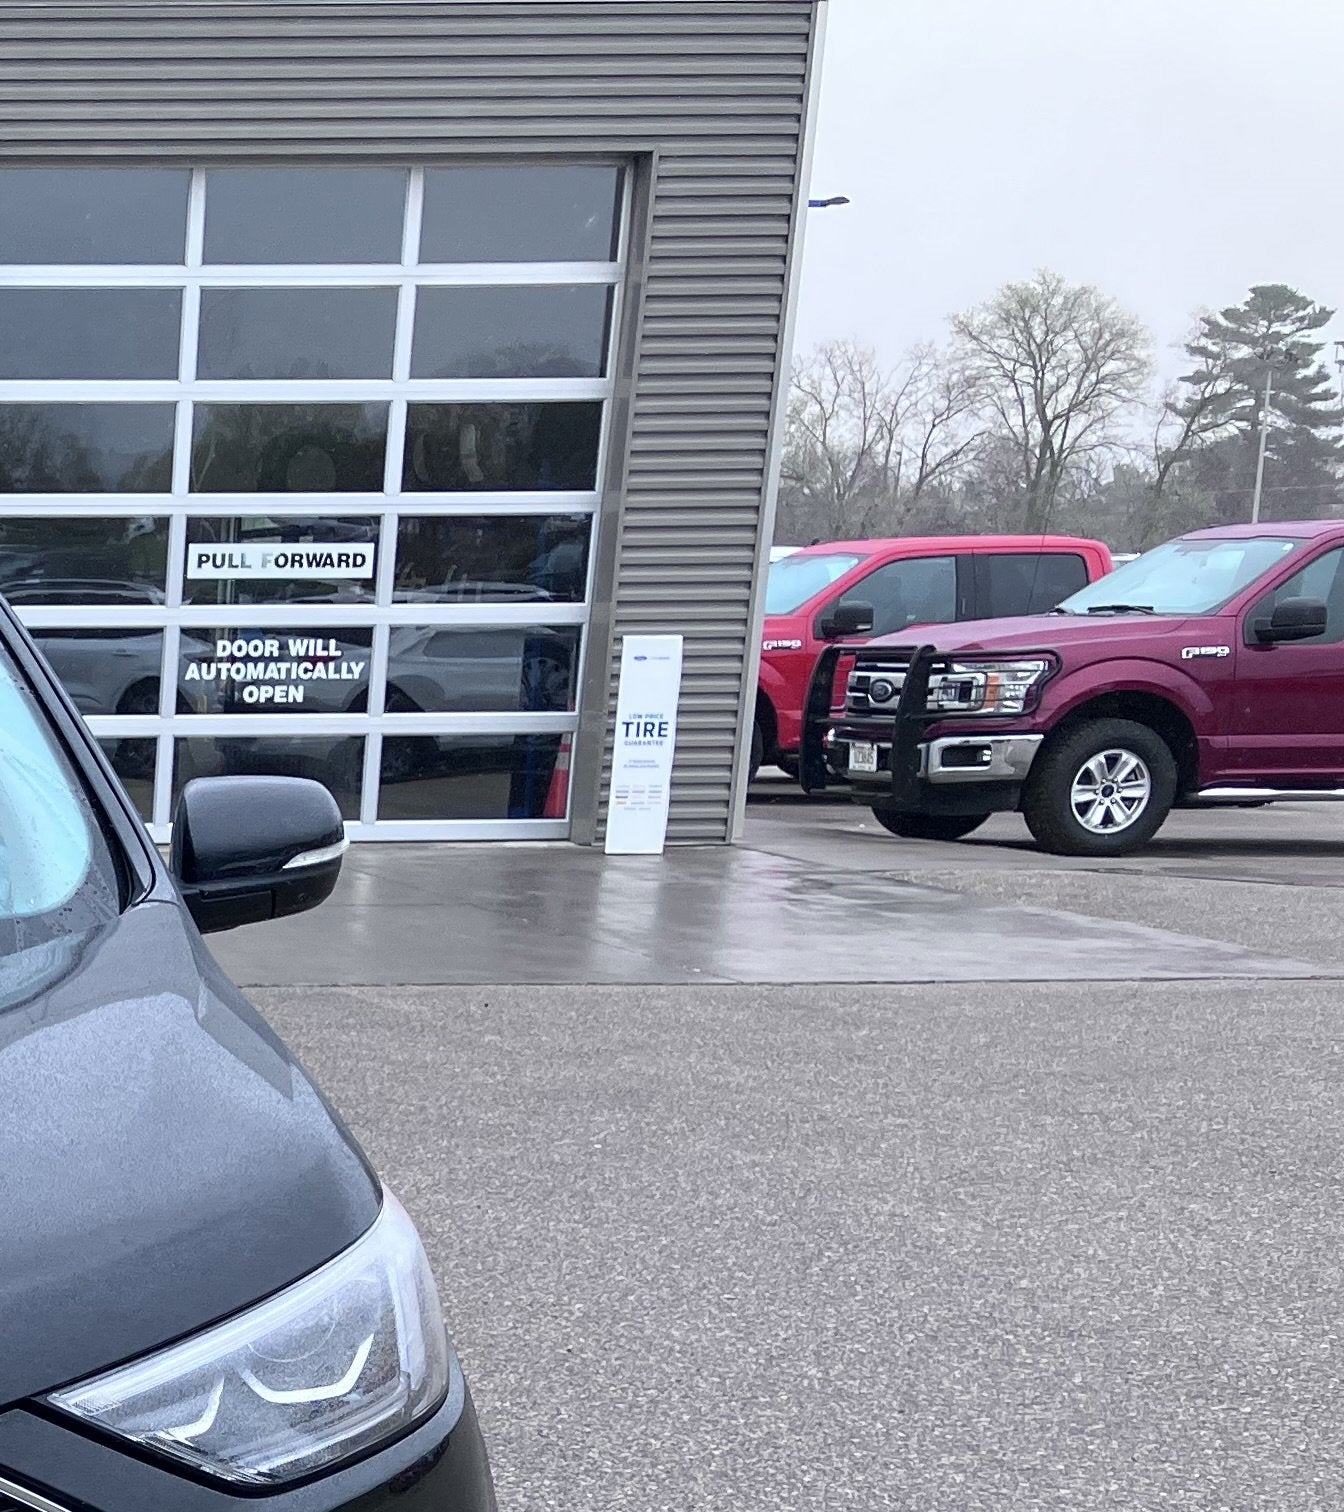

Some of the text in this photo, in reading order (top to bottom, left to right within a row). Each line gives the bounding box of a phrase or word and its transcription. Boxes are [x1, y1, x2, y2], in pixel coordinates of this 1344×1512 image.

[197, 552, 367, 568] PULL FORWARD
[216, 638, 342, 657] DOOR WILL
[184, 661, 365, 680] AUTOMATICALLY
[242, 685, 305, 703] OPEN
[622, 721, 669, 738] TIRE
